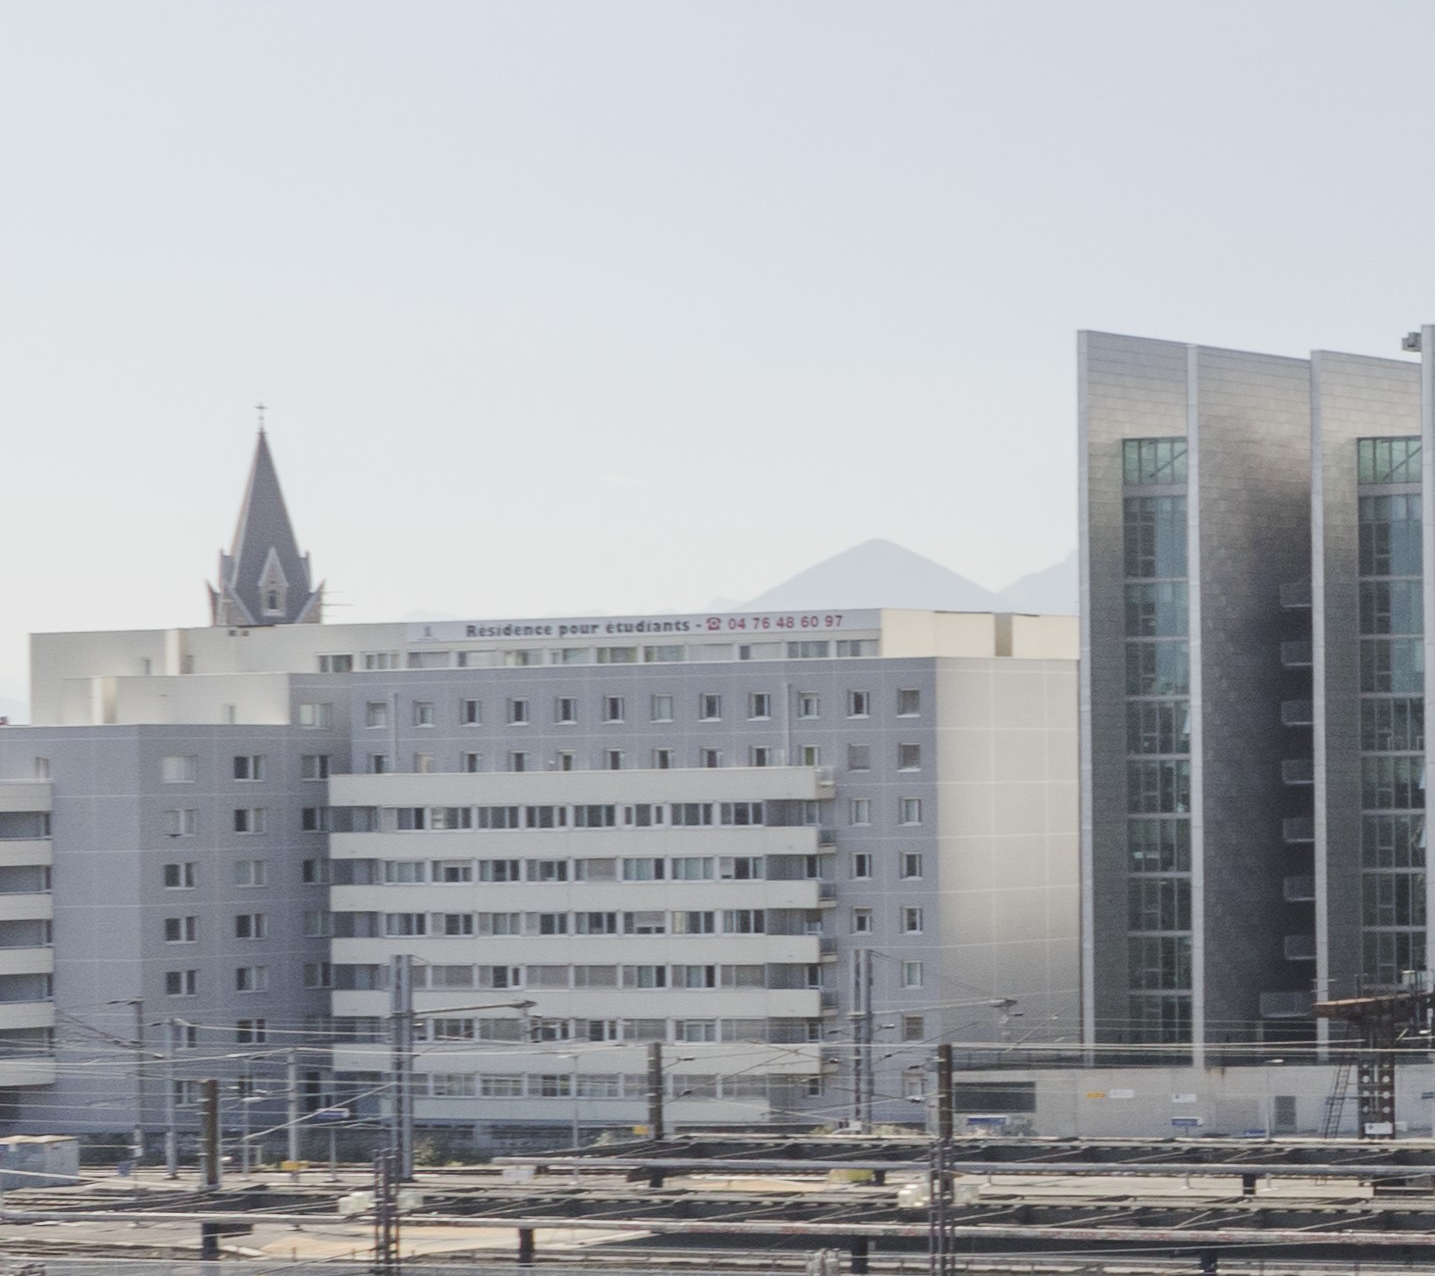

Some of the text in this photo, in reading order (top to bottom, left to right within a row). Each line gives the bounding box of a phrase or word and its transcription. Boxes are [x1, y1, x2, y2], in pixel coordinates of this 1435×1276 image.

[559, 624, 599, 638] pour
[728, 618, 746, 630] 04
[752, 617, 770, 629] 76
[776, 616, 795, 629] 48
[801, 615, 819, 628] 60
[824, 614, 843, 627] 97
